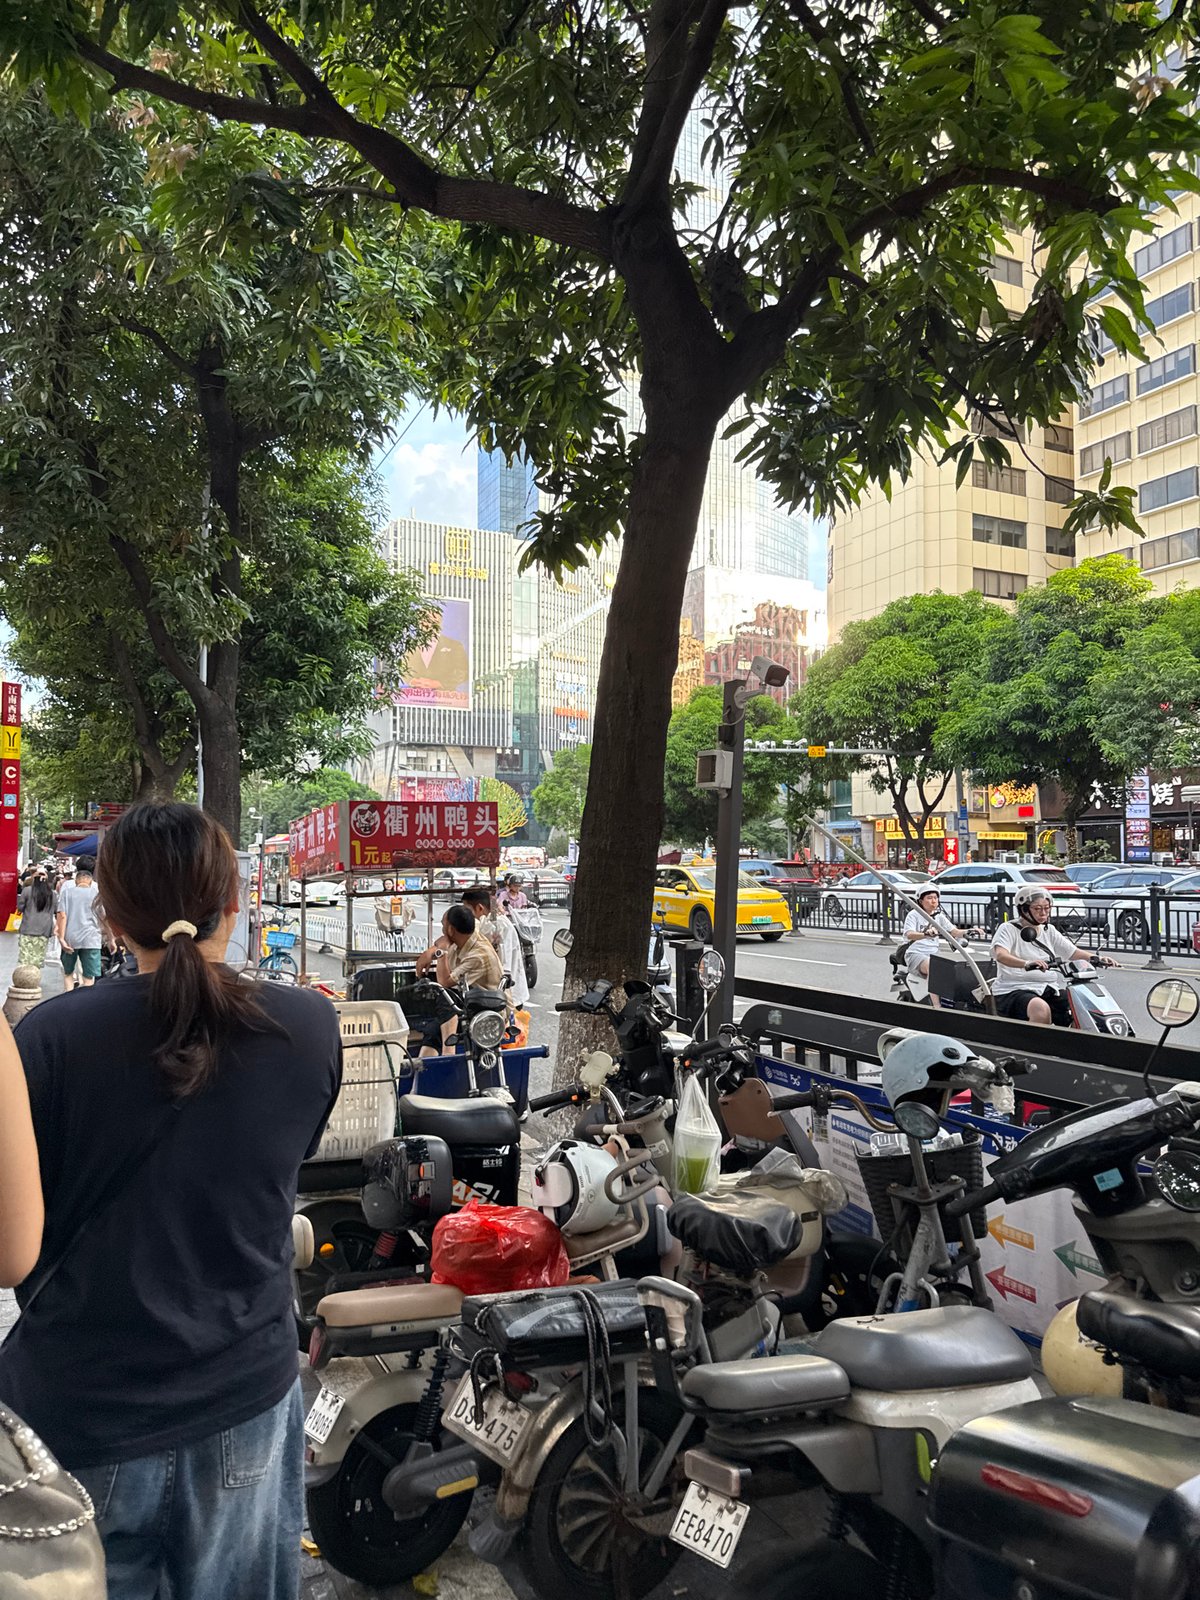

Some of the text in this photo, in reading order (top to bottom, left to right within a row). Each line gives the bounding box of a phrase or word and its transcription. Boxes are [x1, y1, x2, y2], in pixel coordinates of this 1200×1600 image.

[7, 685, 18, 723] 江南西站
[5, 766, 17, 779] C
[383, 803, 497, 838] 衢州鸭头
[351, 840, 392, 865] 1元起
[674, 1508, 734, 1558] FE8470
